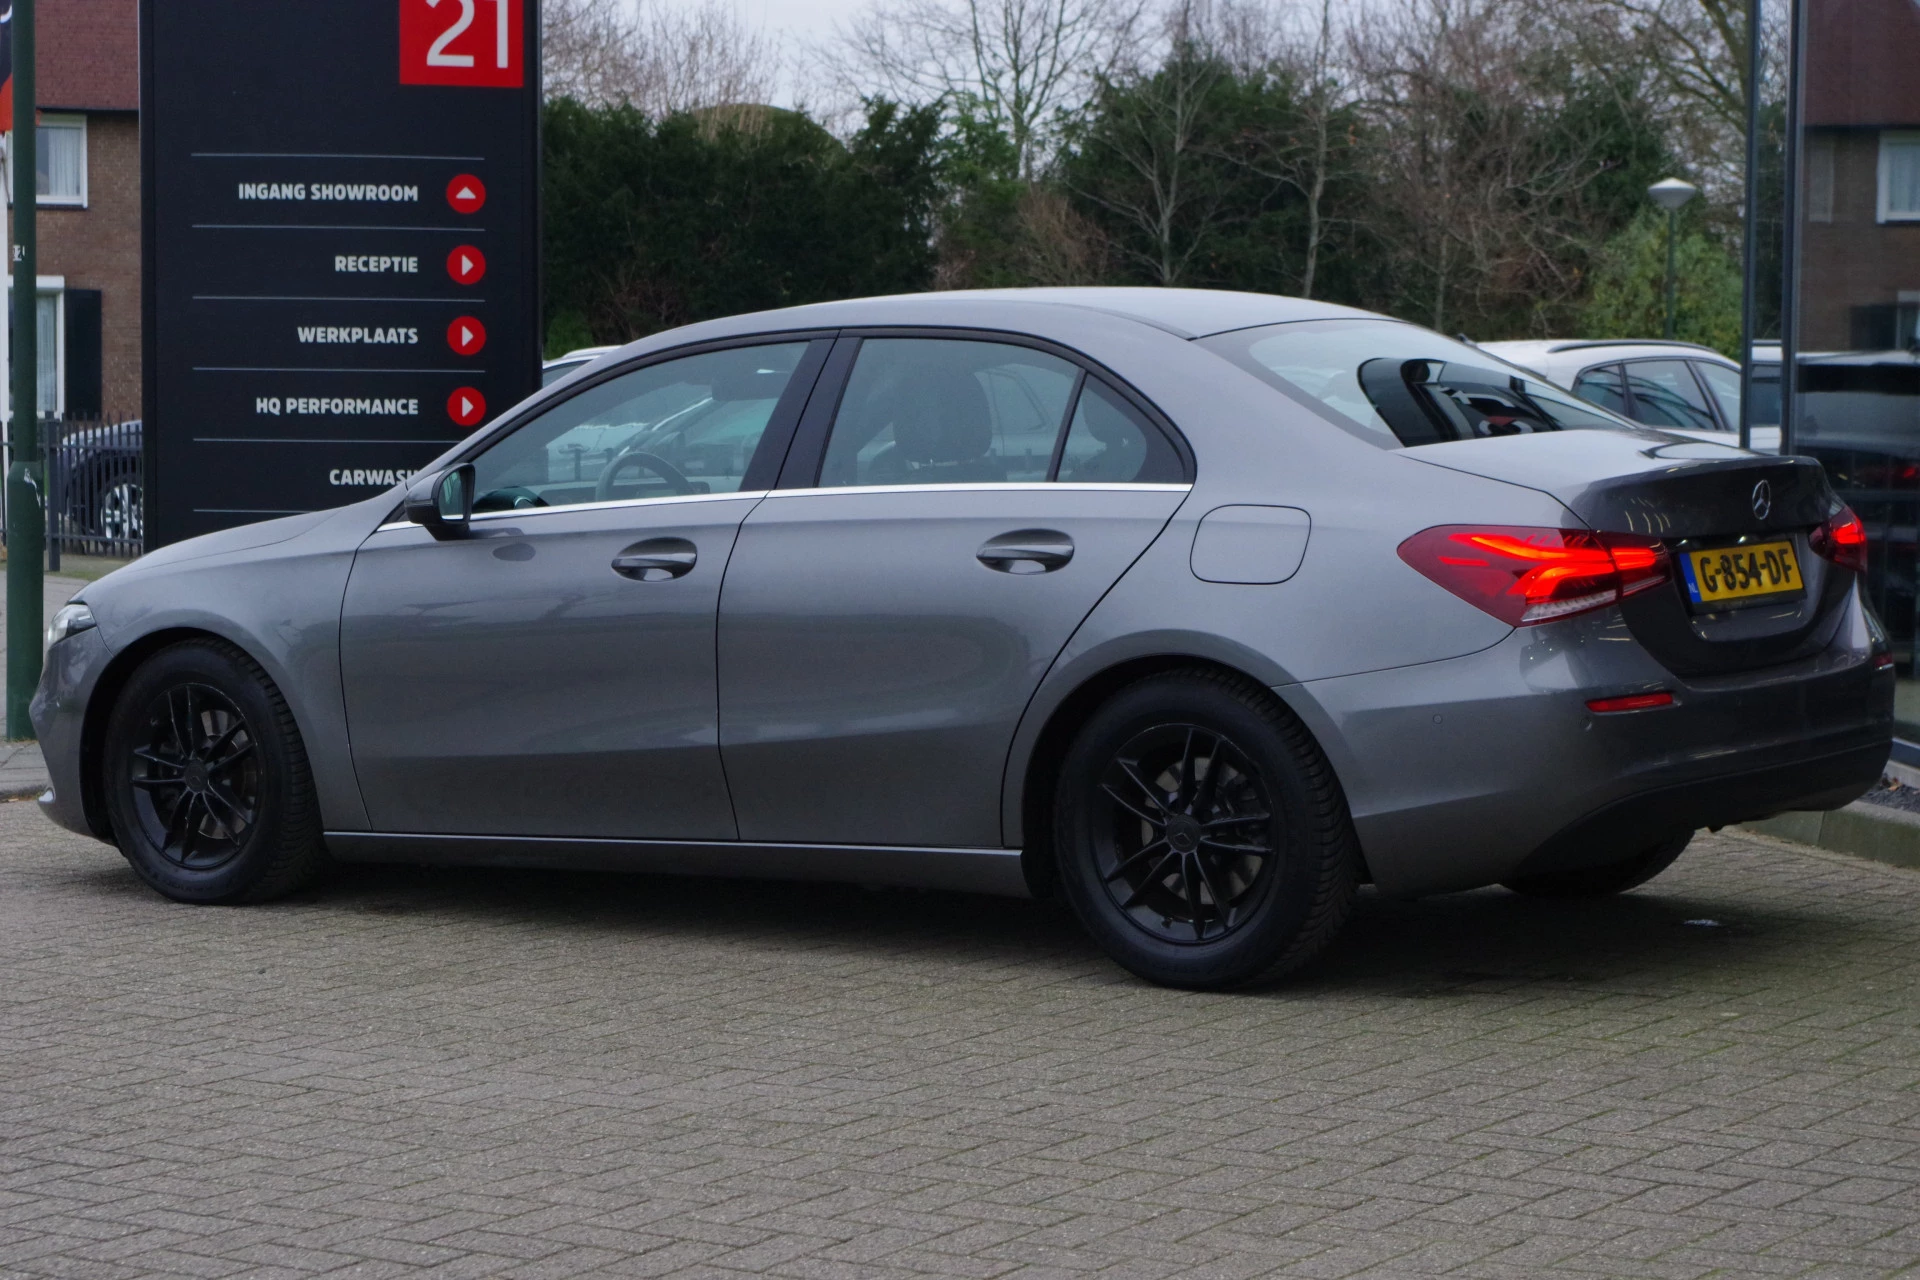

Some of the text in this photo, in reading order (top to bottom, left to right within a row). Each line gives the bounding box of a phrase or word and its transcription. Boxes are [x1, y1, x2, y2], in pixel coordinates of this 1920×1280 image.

[426, 0, 508, 69] 21
[238, 183, 418, 202] INGANG SHOWROOM
[334, 255, 418, 273] RECEPTIE
[298, 327, 418, 344] WERKPLAATS
[256, 398, 418, 416] HQ PERFORMANCE
[1700, 548, 1792, 593] G-854-DF
